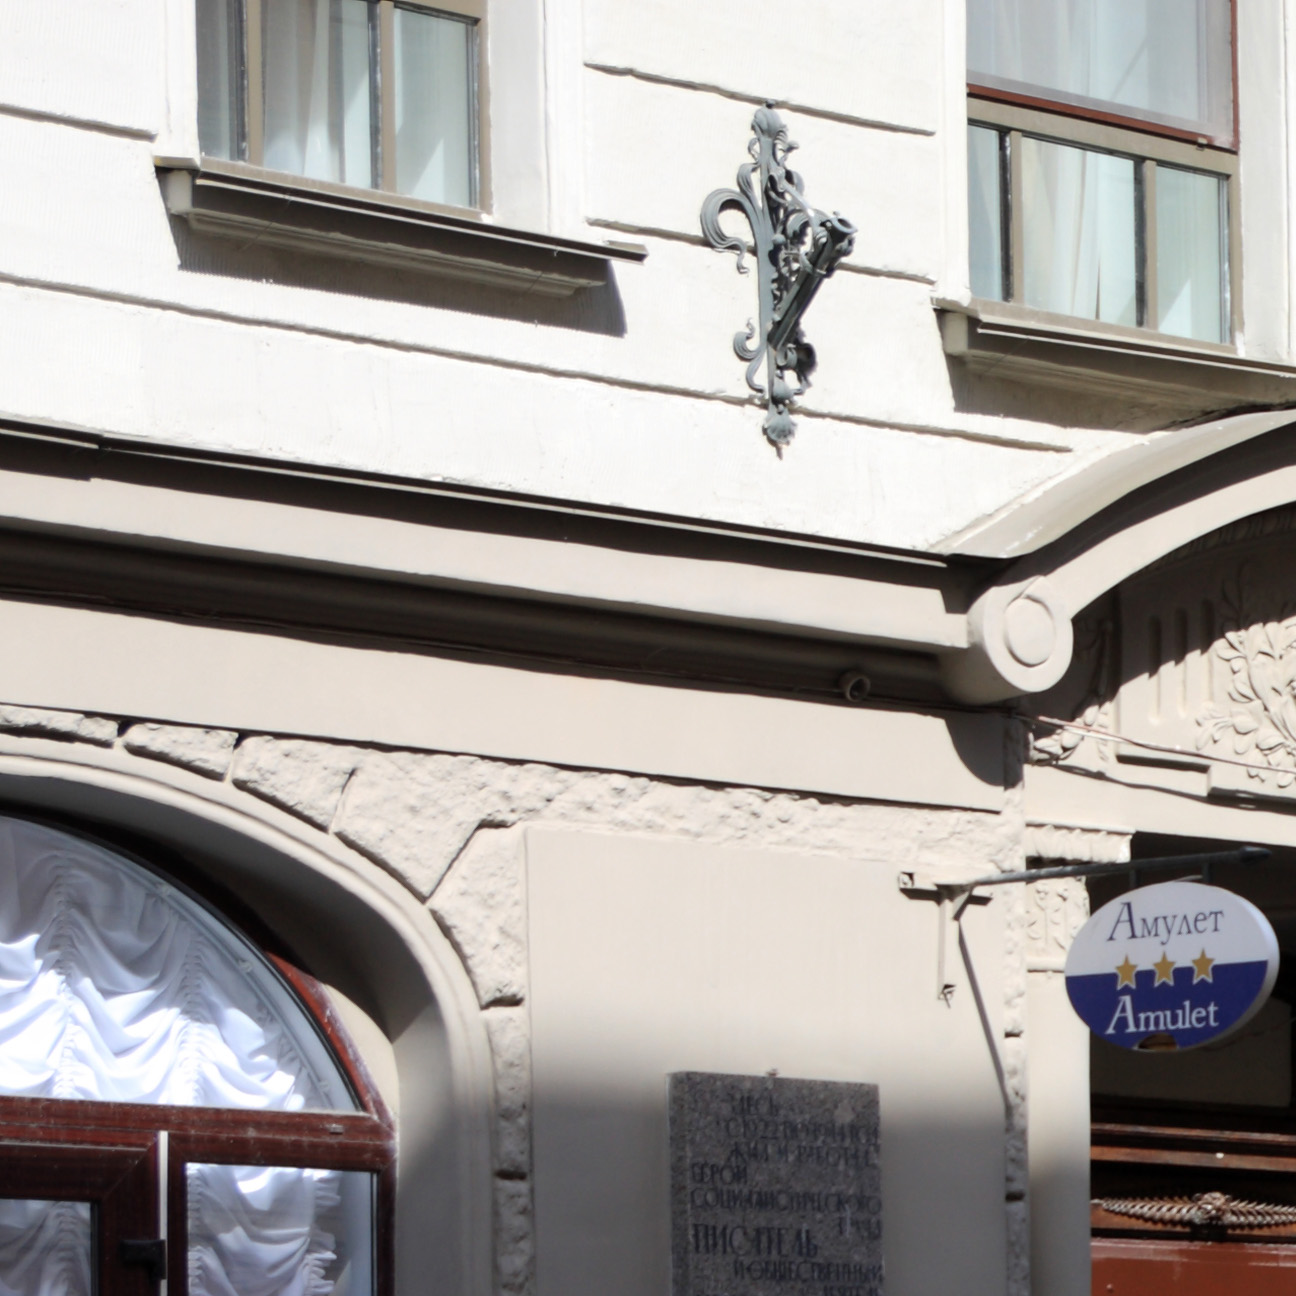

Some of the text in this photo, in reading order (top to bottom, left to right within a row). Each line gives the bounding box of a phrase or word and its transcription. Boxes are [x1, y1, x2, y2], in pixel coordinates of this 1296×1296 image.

[1106, 901, 1225, 945] Амулет
[1104, 995, 1220, 1035] Amulet
[693, 1222, 819, 1259] ПИСАТЕЛЬ
